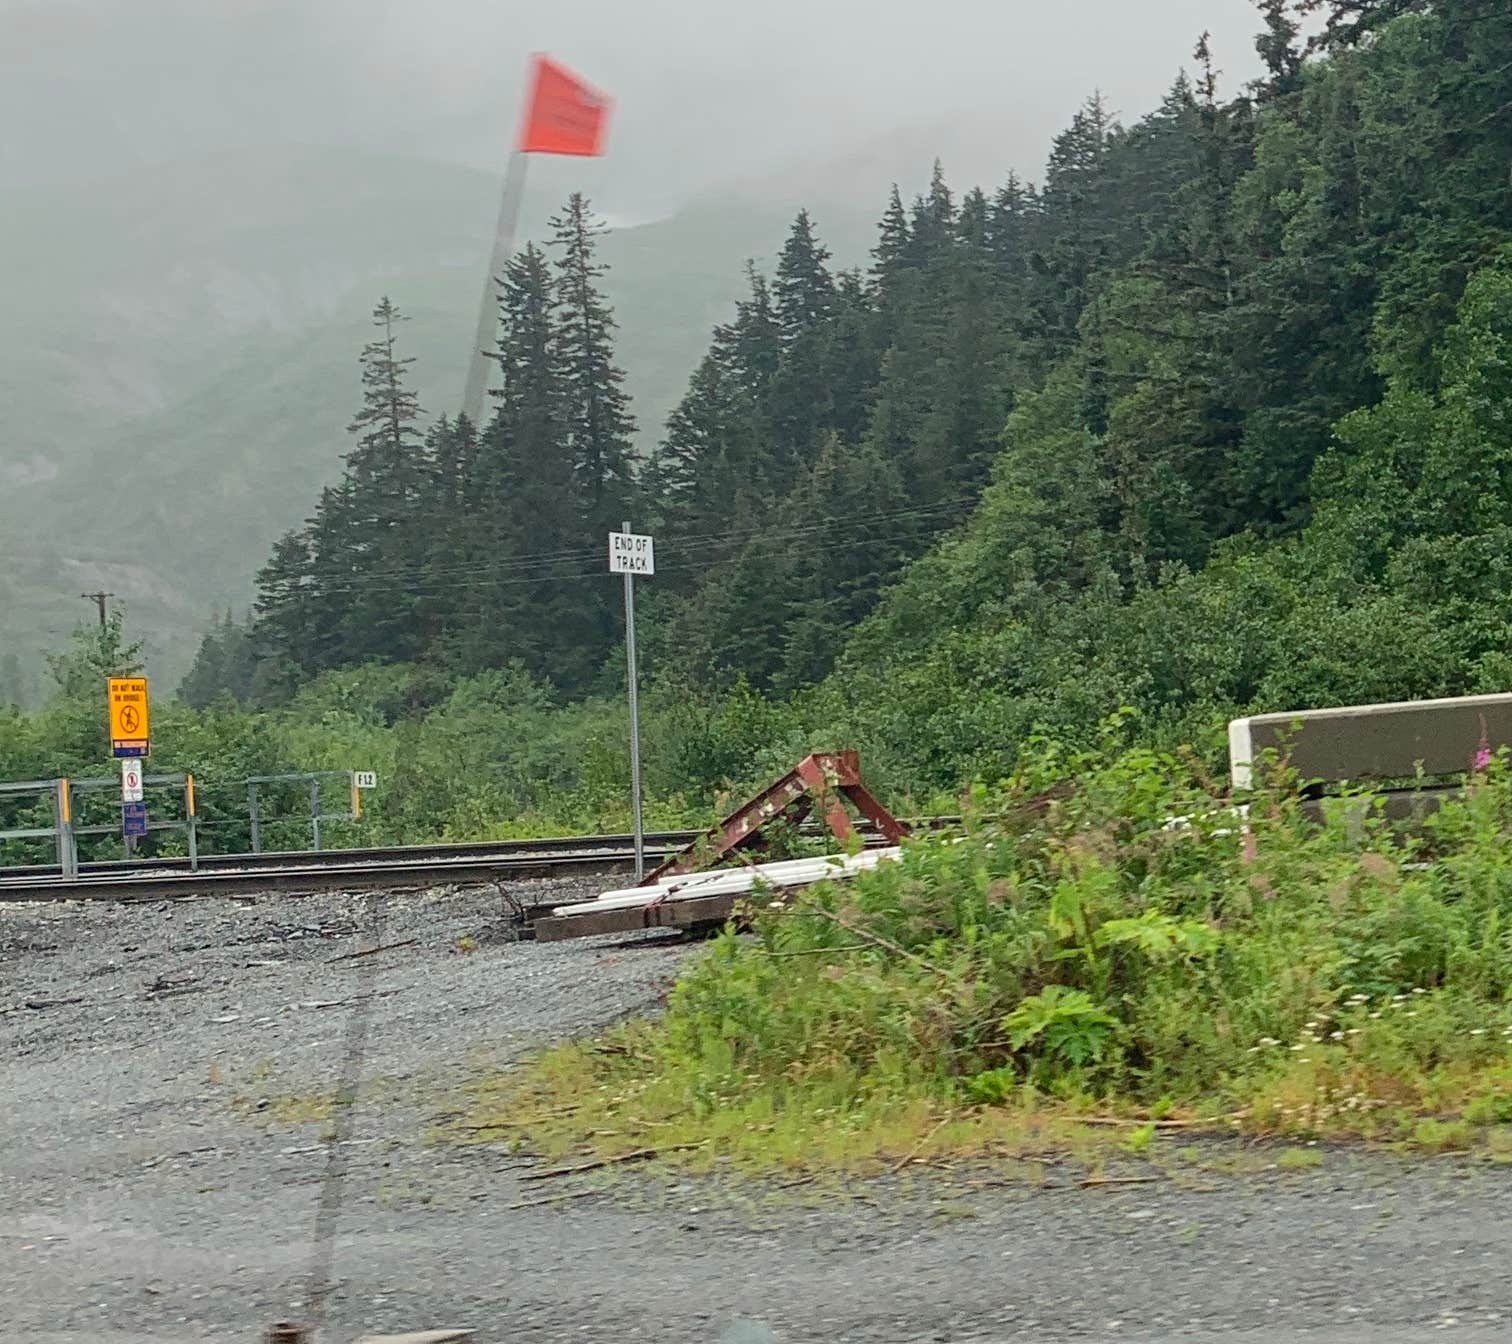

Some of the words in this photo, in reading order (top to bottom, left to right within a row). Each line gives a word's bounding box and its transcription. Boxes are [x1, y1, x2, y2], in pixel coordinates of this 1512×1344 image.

[615, 536, 633, 551] END
[636, 538, 647, 552] OF
[616, 555, 648, 571] TRACK
